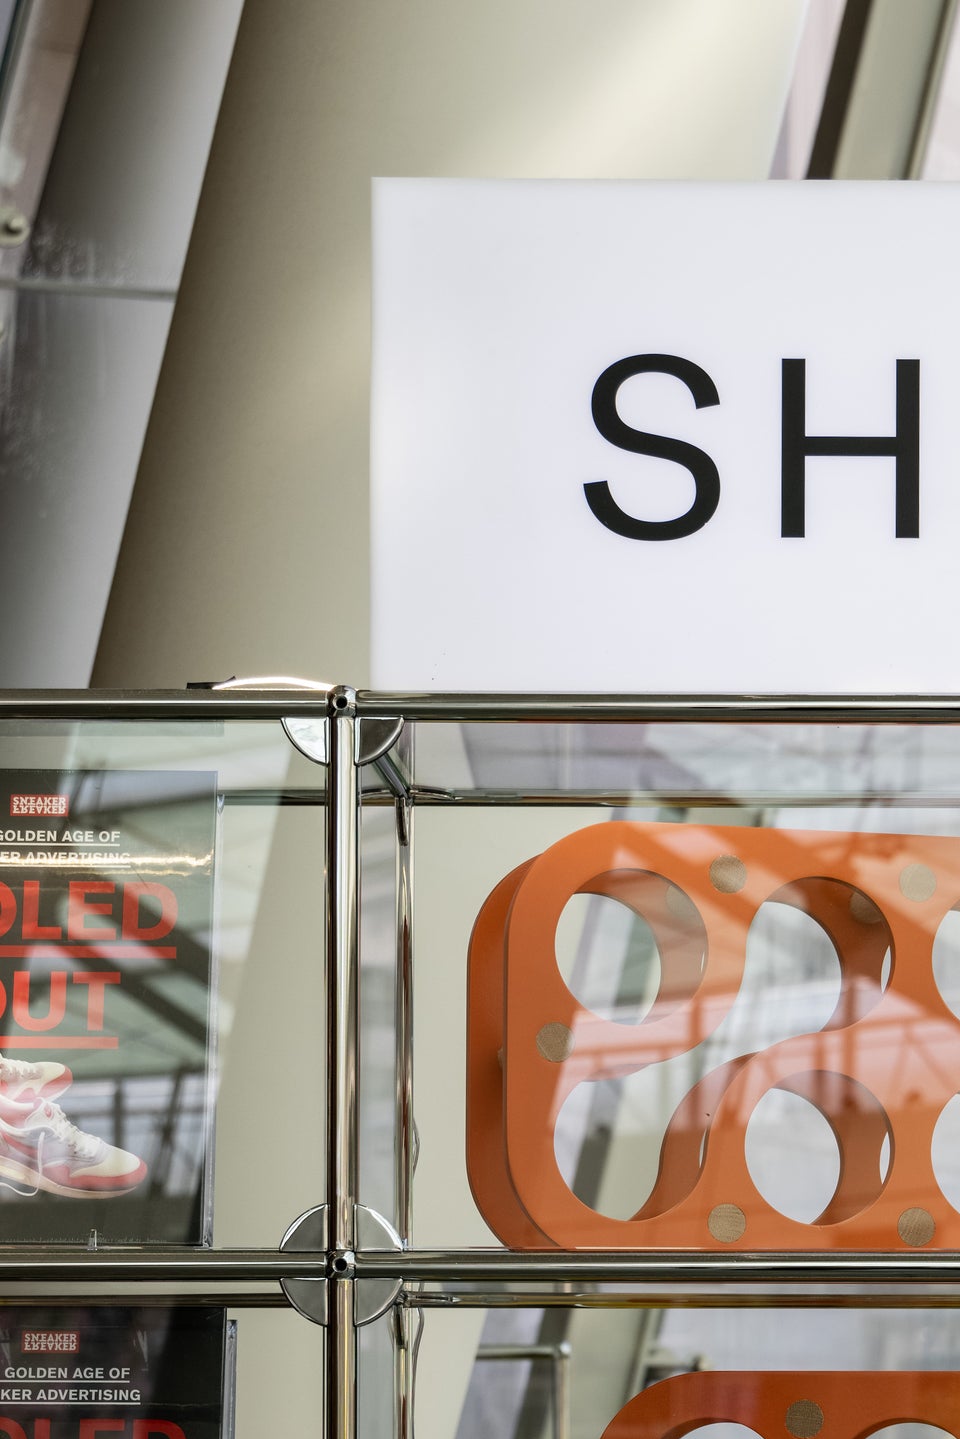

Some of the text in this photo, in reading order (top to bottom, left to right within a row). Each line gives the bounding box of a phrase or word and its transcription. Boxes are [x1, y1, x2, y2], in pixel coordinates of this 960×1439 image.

[12, 796, 66, 806] SNEAKER
[62, 830, 94, 842] AGE
[98, 831, 121, 842] OF
[0, 880, 179, 941] LED
[0, 970, 121, 1032] UT
[24, 1333, 77, 1342] SNEAKER
[4, 1367, 131, 1379] GOLDEN AGE OF
[36, 1389, 141, 1401] ADVERTISING
